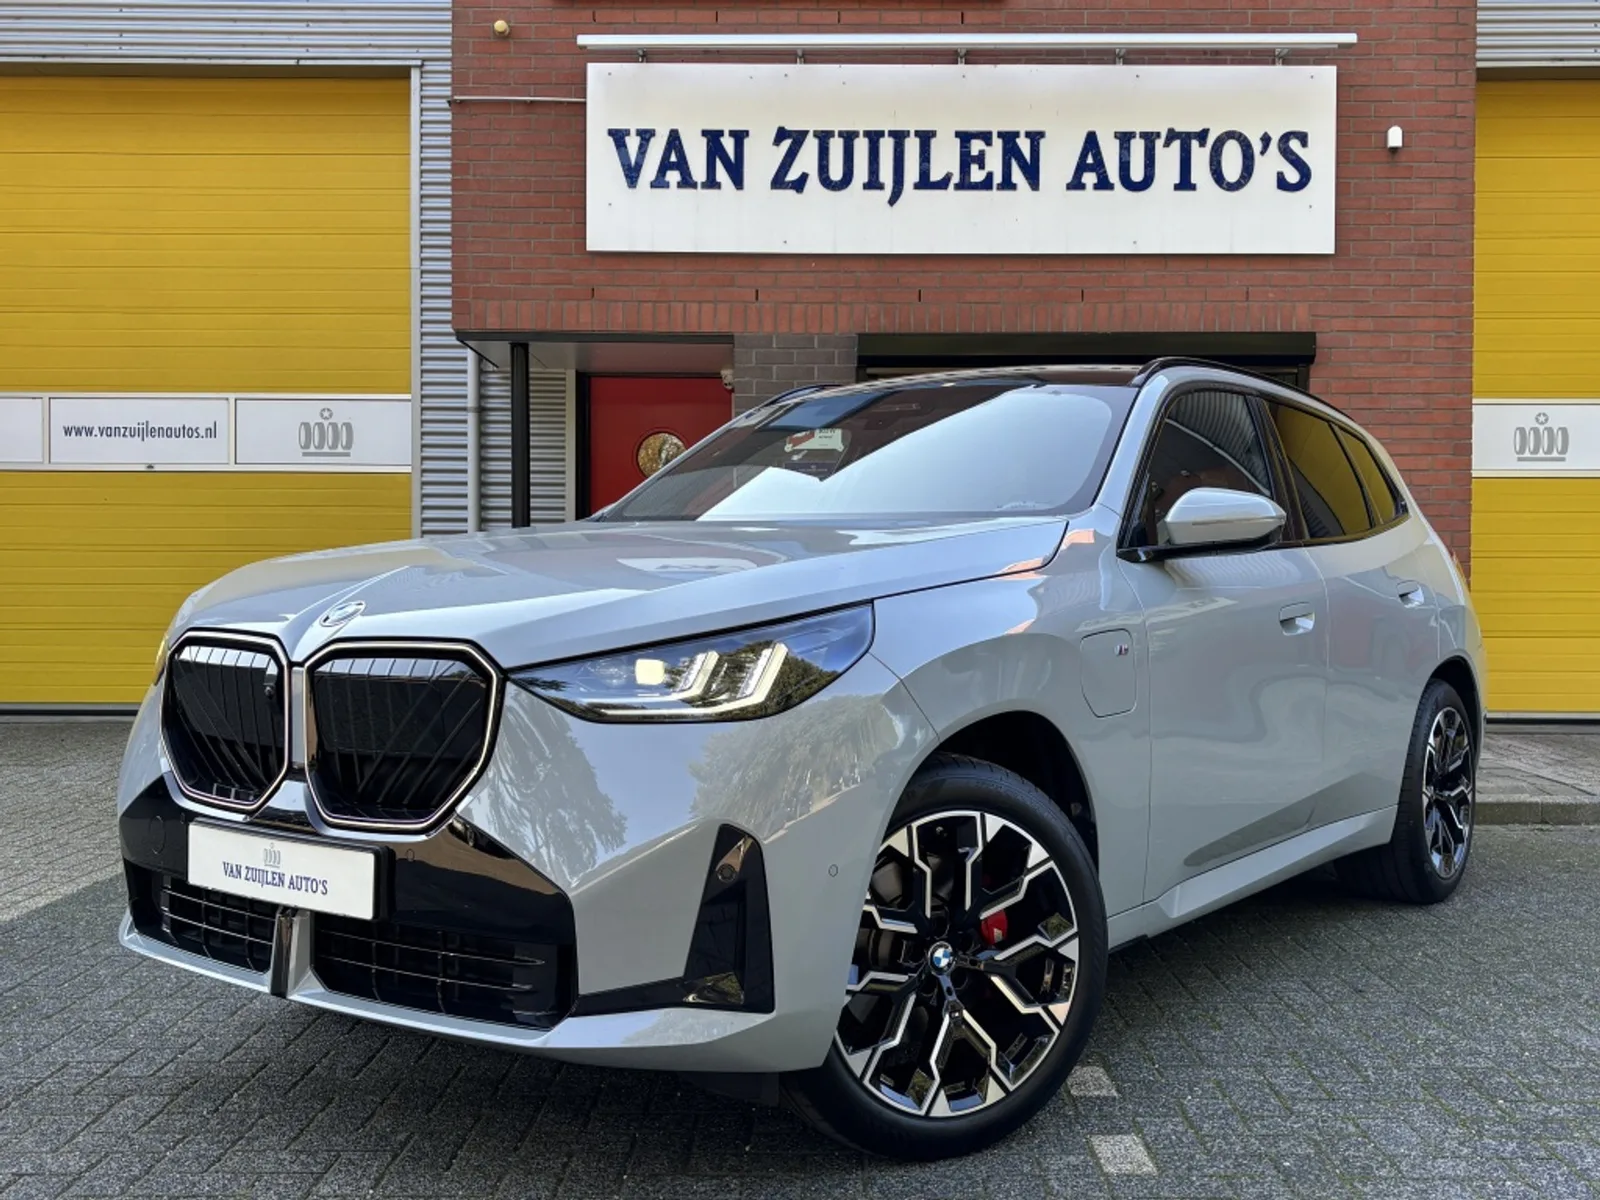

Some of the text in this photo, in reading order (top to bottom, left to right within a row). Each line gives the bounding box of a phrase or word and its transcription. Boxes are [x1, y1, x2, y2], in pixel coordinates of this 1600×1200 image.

[607, 126, 1312, 206] VAN ZUIJLEN AUTO'S
[63, 421, 217, 442] www.vanzuijlenautos.nl
[223, 862, 328, 895] VAN ZUIJLEN AUTO'S
